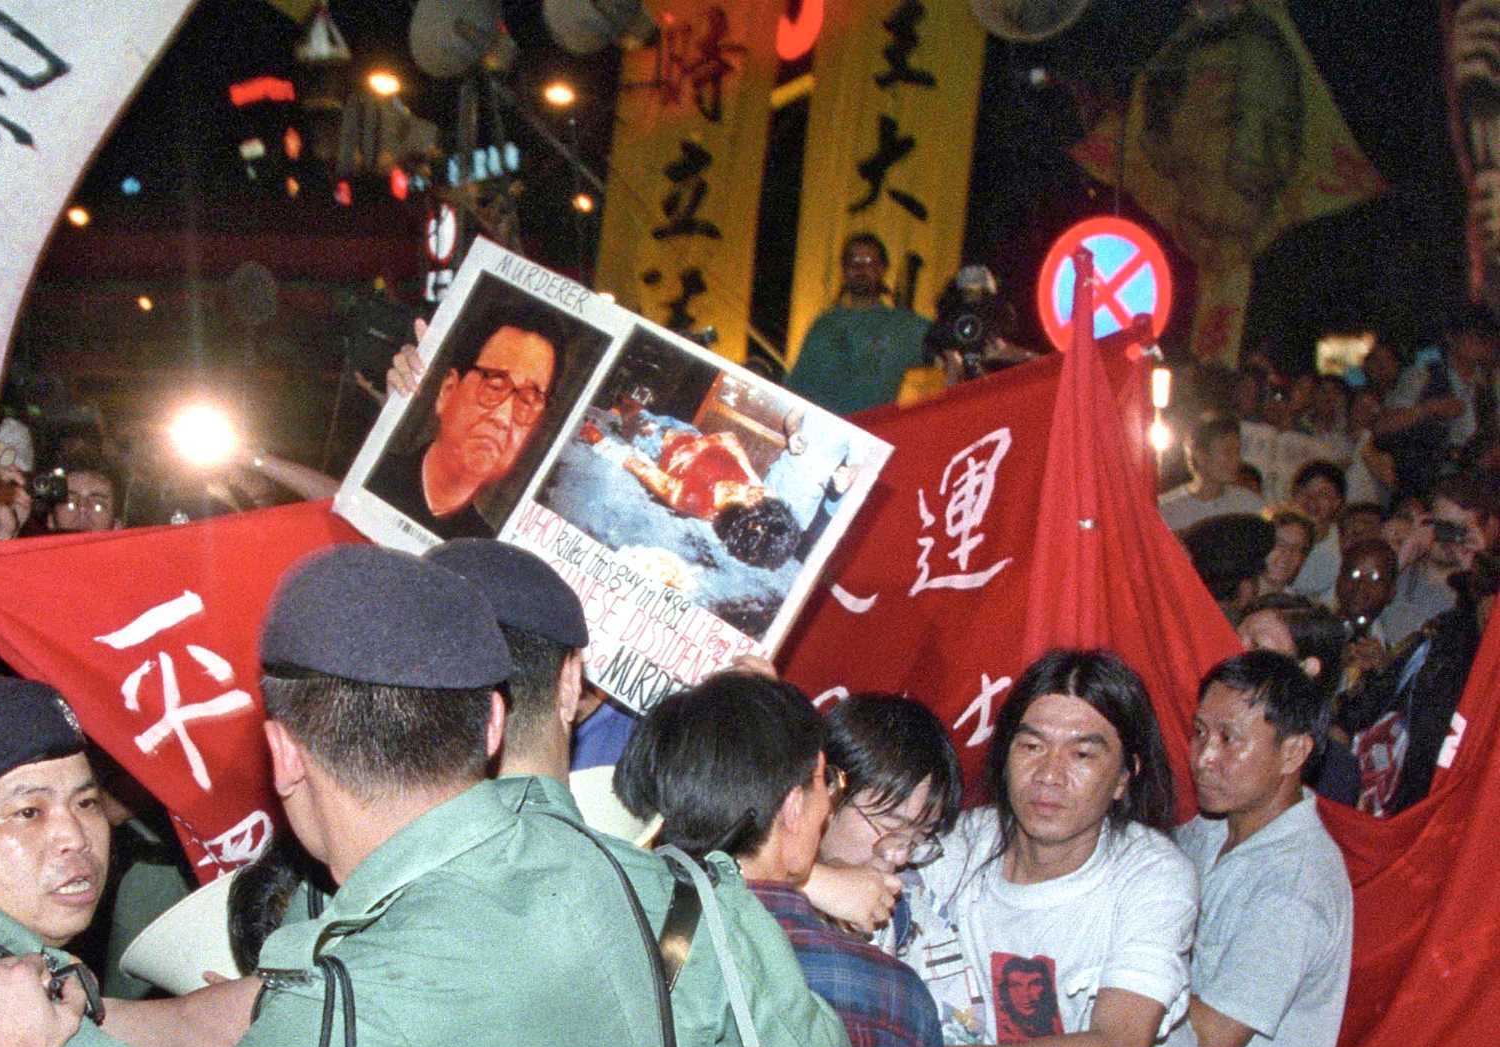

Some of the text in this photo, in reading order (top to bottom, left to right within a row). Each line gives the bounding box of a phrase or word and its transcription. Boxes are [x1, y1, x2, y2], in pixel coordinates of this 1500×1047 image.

[495, 254, 591, 313] MURDERER
[515, 503, 563, 549] WHO
[550, 523, 595, 567] killed
[586, 545, 617, 586] this
[609, 564, 646, 601] guy
[635, 578, 656, 610] in
[598, 645, 690, 710] MURDE
